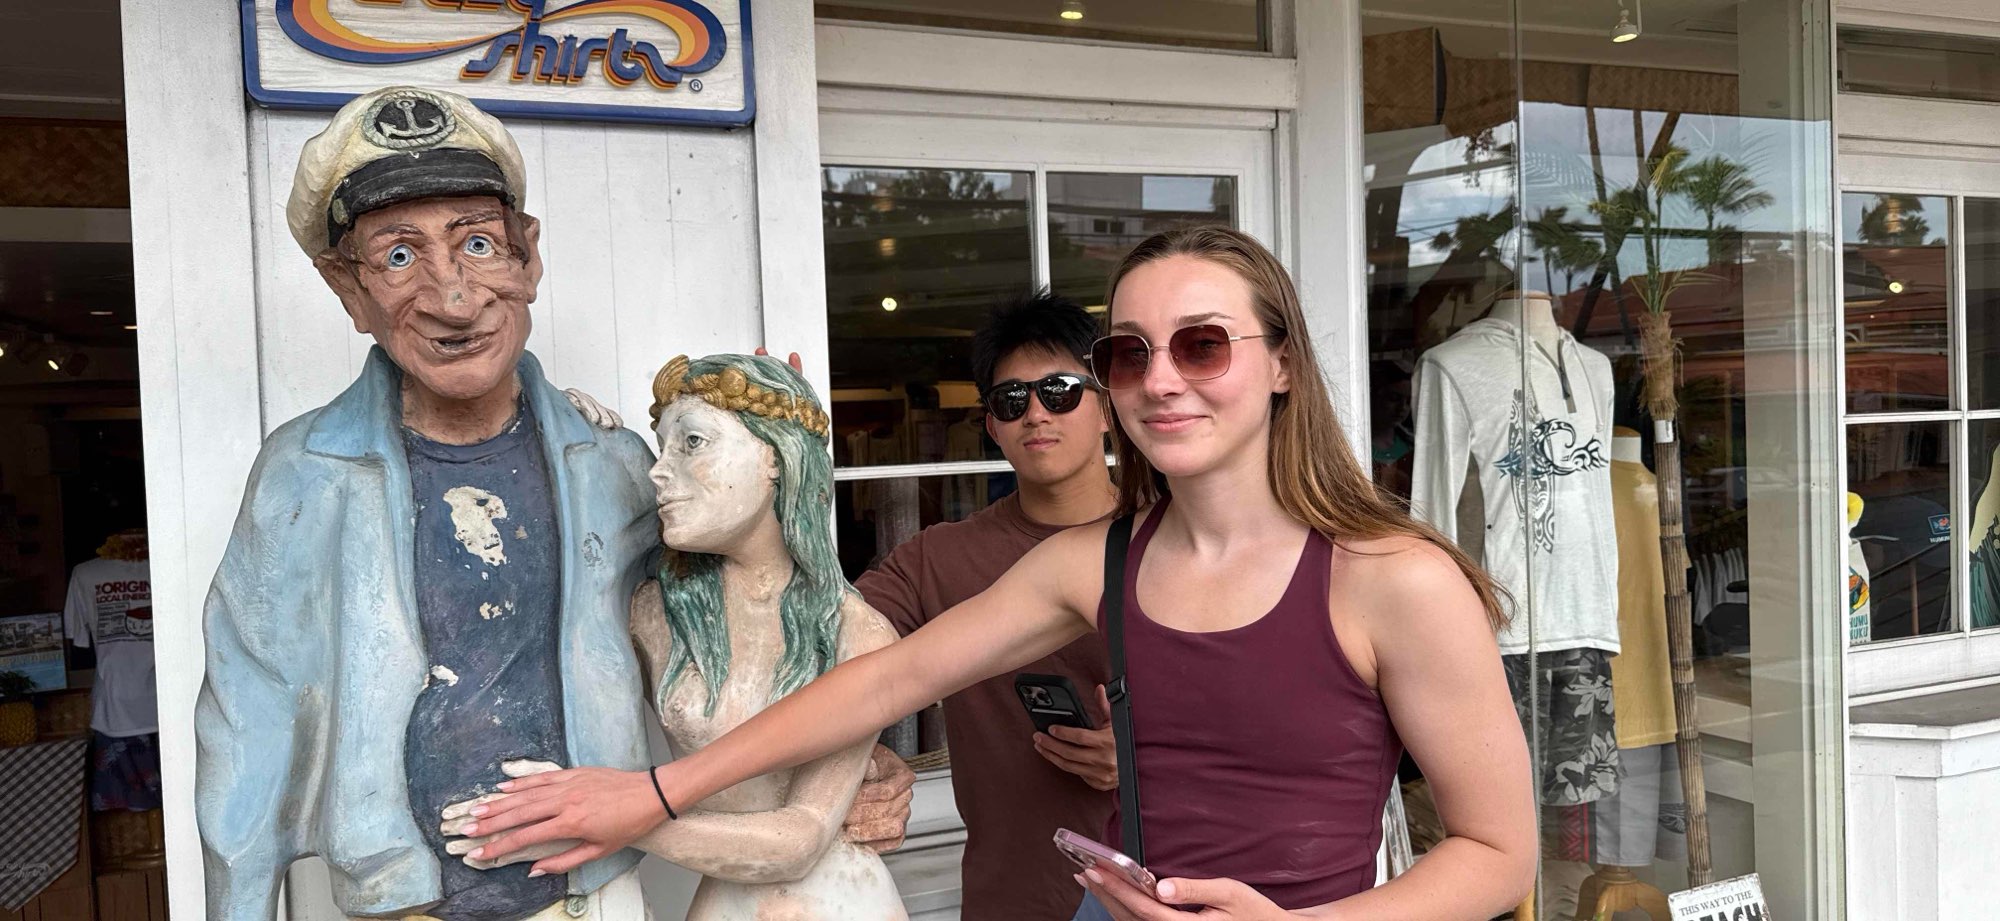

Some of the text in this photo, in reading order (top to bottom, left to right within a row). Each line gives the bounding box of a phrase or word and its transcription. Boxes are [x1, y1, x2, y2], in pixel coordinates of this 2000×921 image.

[1679, 904, 1700, 917] THIS
[1700, 898, 1721, 910] WAY
[1720, 894, 1735, 906] TO
[1735, 889, 1754, 902] THE
